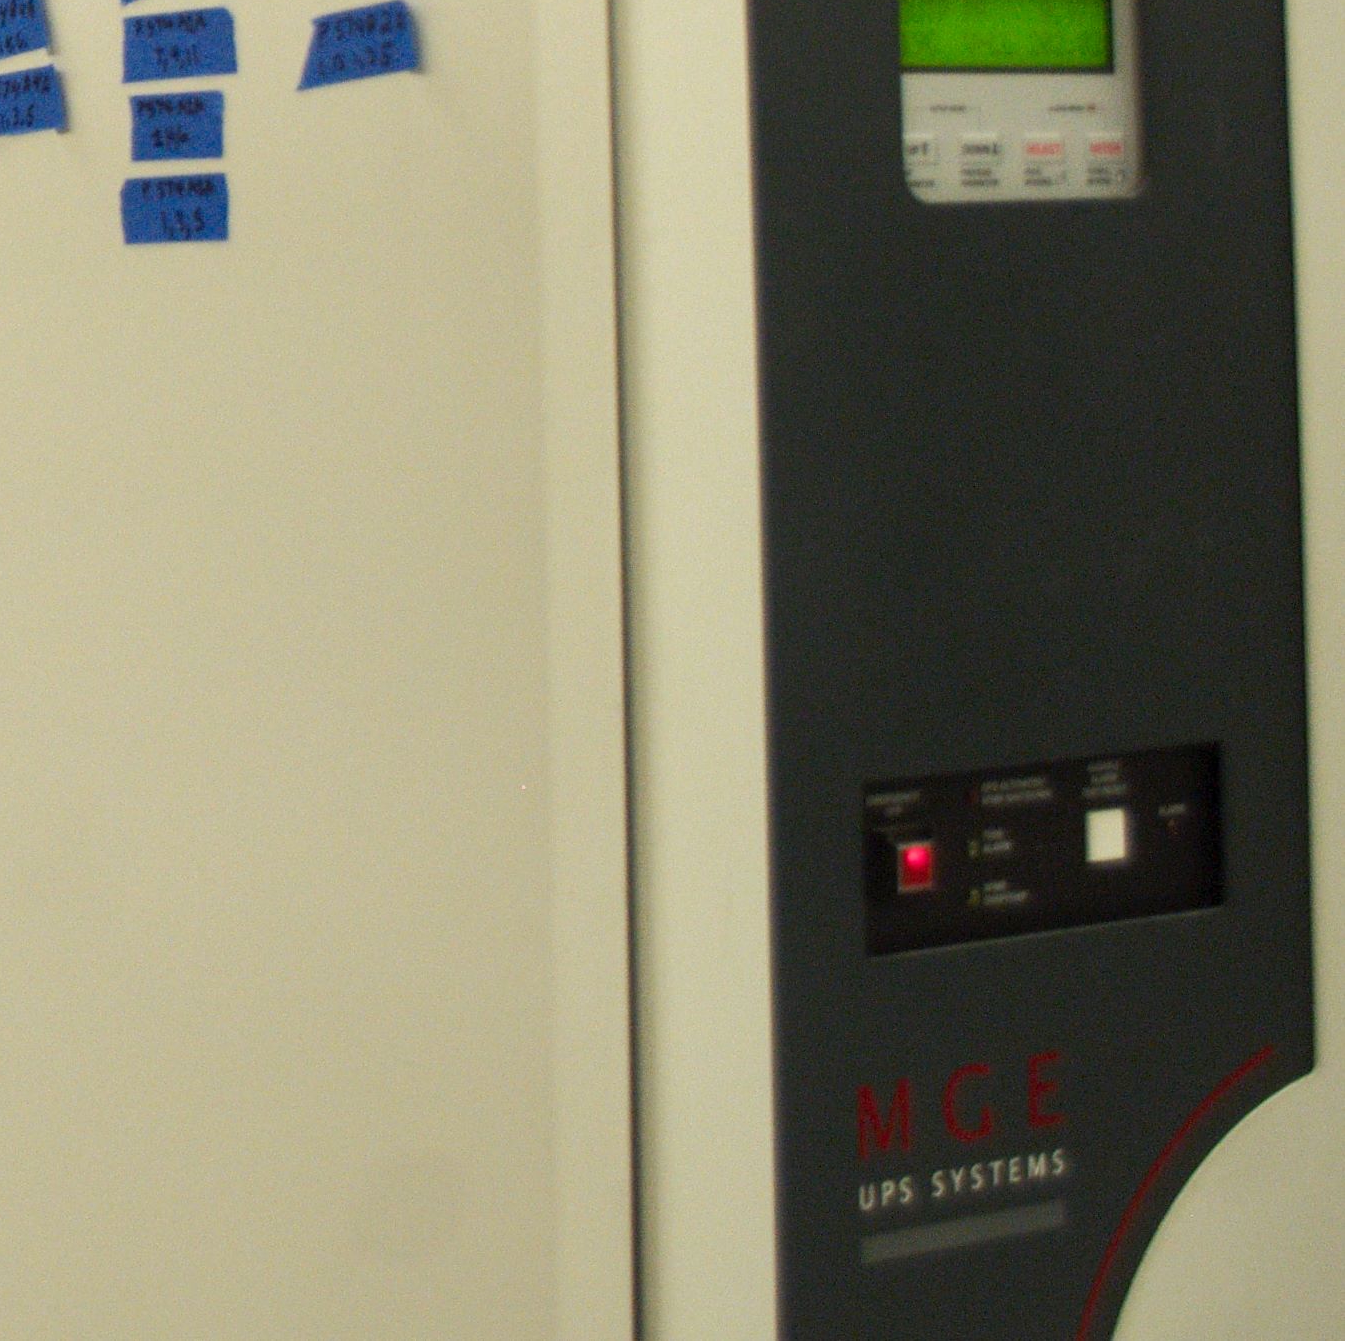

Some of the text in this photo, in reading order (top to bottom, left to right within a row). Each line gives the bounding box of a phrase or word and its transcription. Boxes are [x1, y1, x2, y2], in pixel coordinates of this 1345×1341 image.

[855, 1051, 1066, 1161] MGE
[858, 1149, 1068, 1212] UPS SYSTEMS
